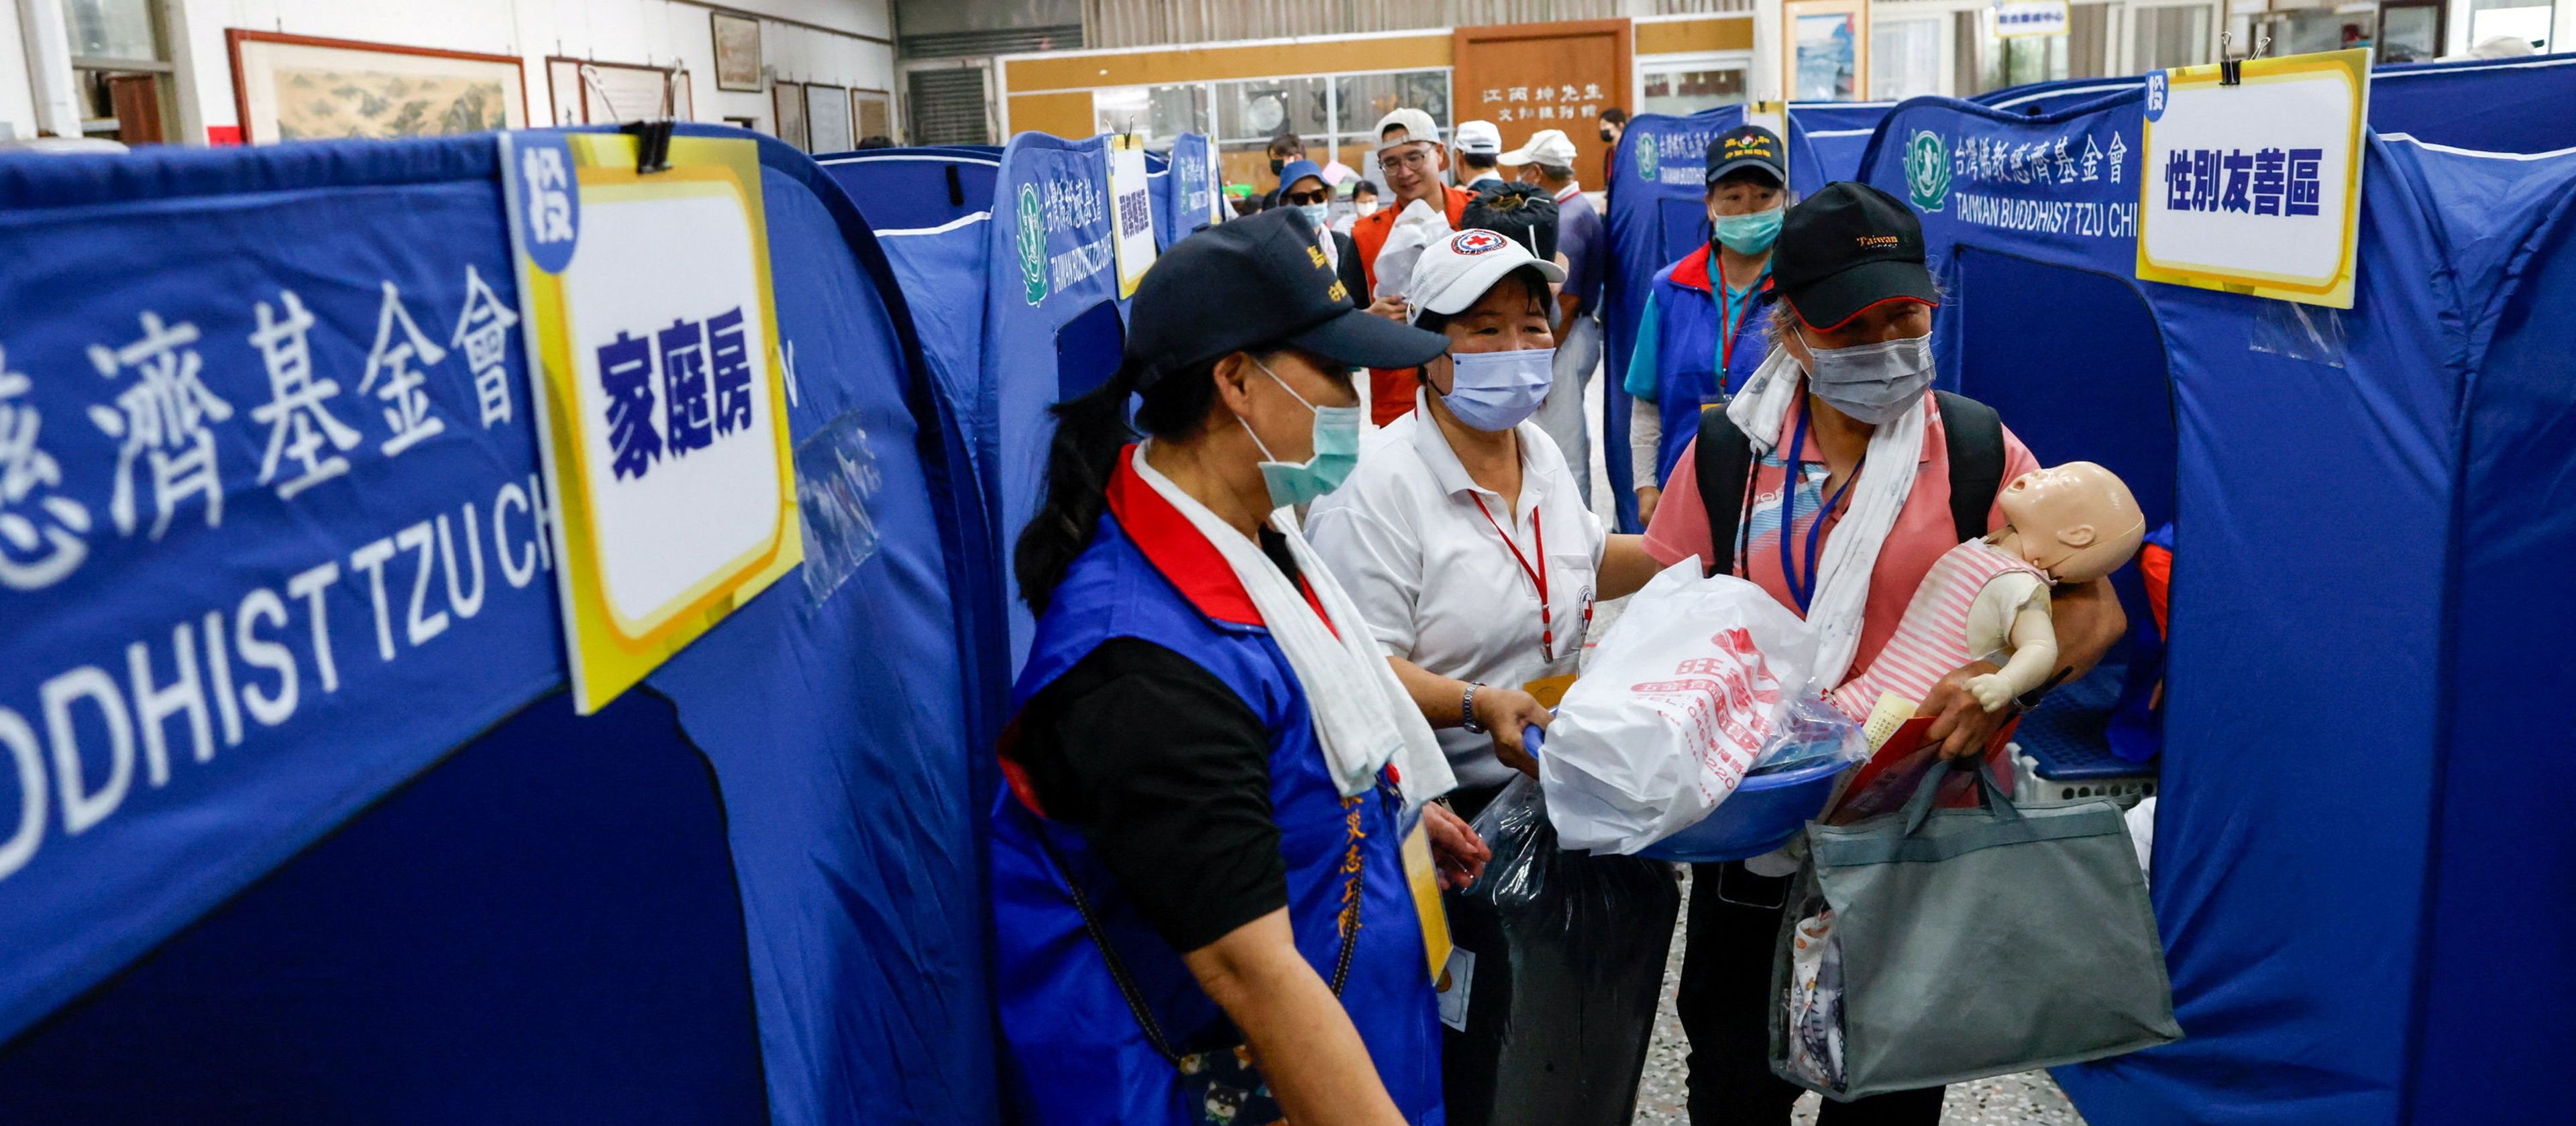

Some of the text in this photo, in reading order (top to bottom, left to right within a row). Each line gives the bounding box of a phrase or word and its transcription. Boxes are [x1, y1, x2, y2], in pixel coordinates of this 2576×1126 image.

[2148, 75, 2164, 111] 投
[1955, 131, 2127, 185] 台灣佛教慈濟基金會
[2165, 148, 2322, 217] 性別友善區
[523, 147, 574, 243] 投
[1955, 192, 2138, 237] TAIWAN BUDDHIST TZU CHI
[1856, 234, 1898, 247] Taiwan
[596, 306, 753, 482] 家庭房
[350, 502, 485, 661] TZU
